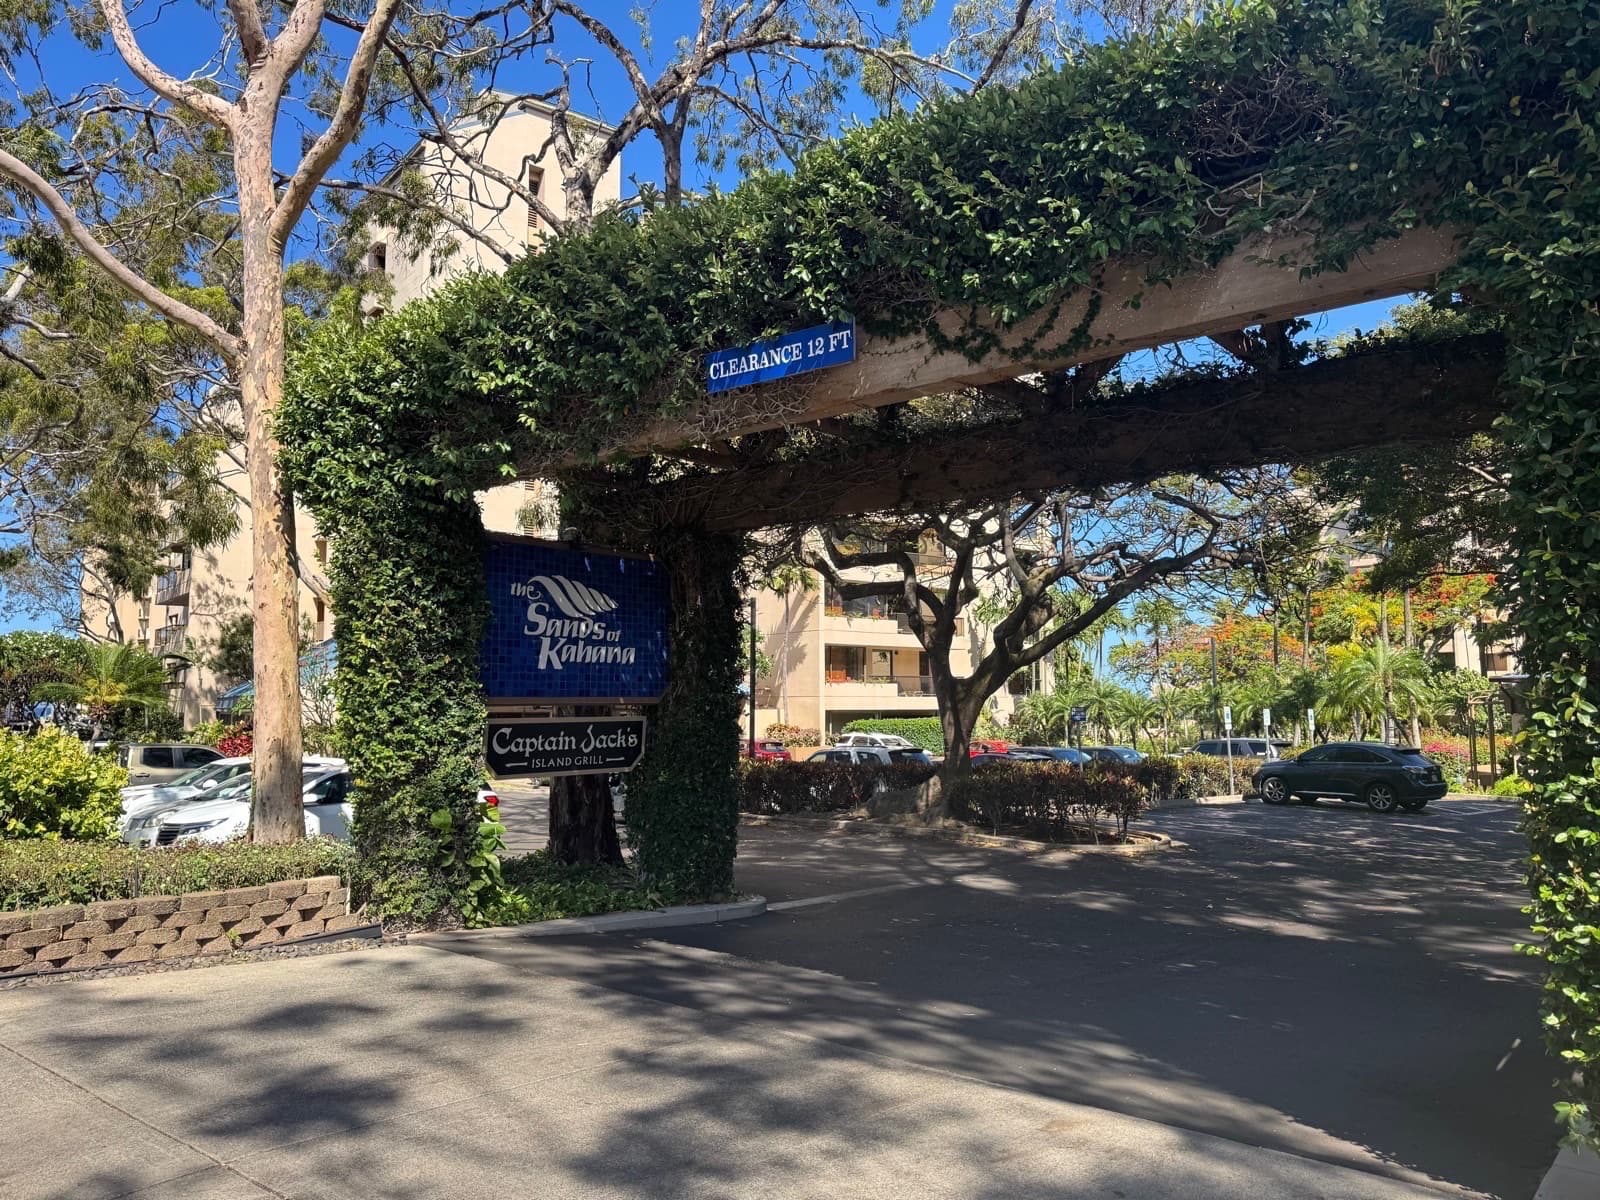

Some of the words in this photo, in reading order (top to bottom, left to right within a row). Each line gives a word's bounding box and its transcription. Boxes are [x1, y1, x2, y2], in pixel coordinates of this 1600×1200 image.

[709, 342, 802, 380] CLEARANCE
[807, 337, 825, 358] 12
[828, 330, 851, 352] FT
[510, 582, 541, 600] the
[524, 602, 606, 640] Sands
[606, 629, 621, 642] of
[537, 636, 636, 670] Kahana
[492, 727, 577, 757] Captain
[580, 724, 639, 753] Jack's
[531, 757, 572, 769] ISLAND
[574, 755, 604, 766] GRILL
